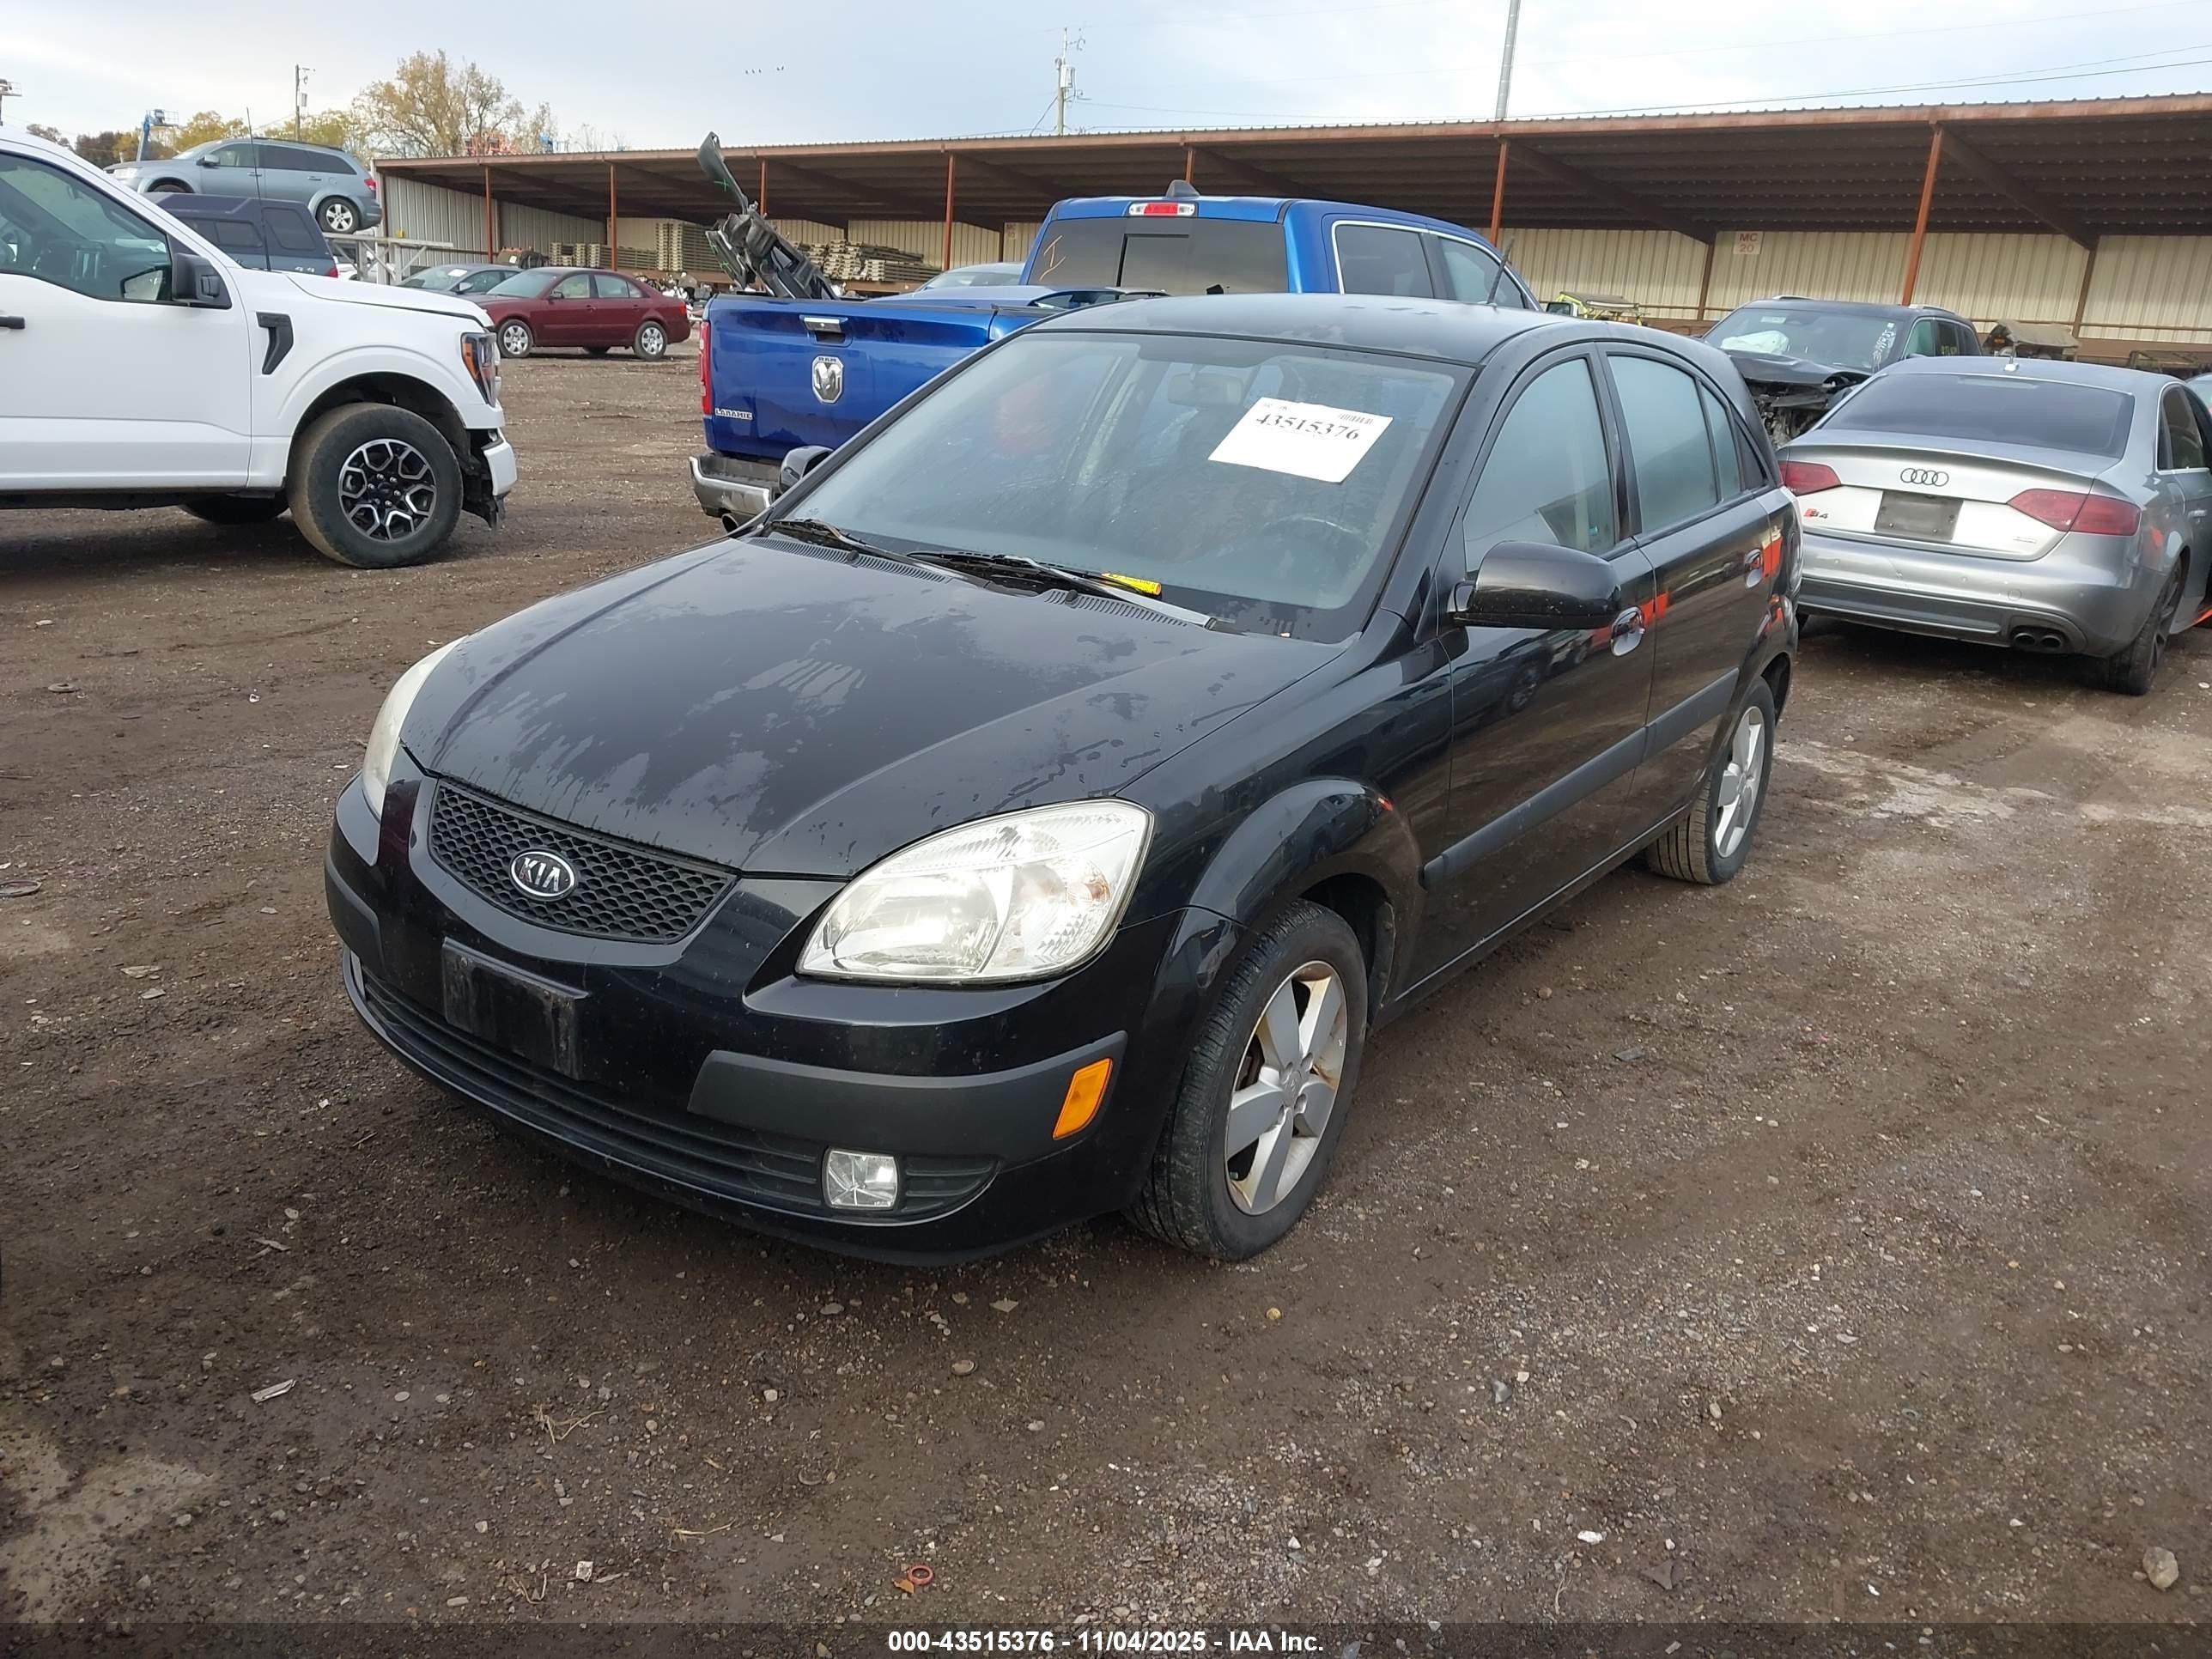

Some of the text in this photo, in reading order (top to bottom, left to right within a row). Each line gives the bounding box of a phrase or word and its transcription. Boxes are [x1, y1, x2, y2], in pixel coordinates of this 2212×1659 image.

[1740, 233, 1759, 241] MC
[1739, 244, 1754, 252] 20
[714, 408, 753, 420] LARAMIE
[1256, 413, 1360, 440] 43515376
[519, 857, 561, 892] KIA
